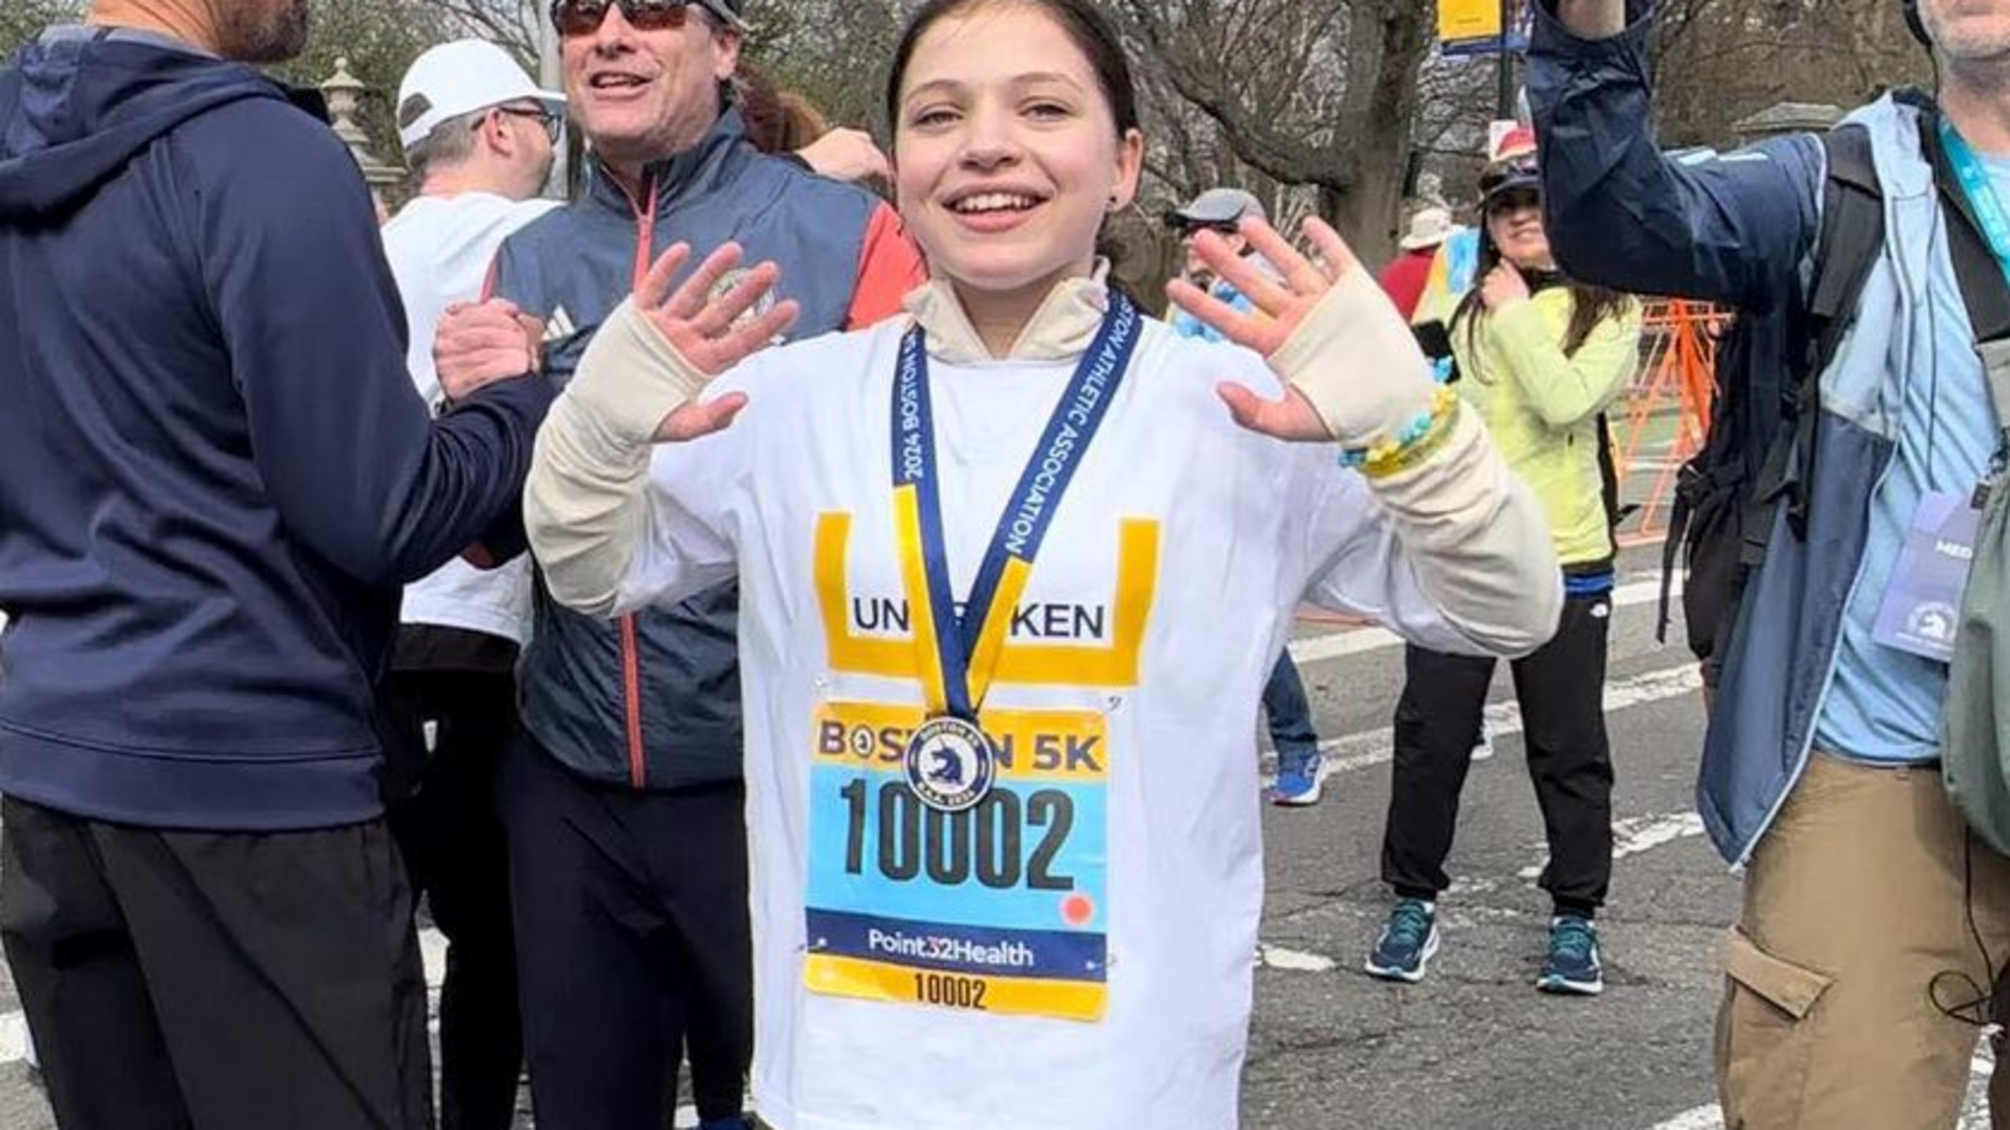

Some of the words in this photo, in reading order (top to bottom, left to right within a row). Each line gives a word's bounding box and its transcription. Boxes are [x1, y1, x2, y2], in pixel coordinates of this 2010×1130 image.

[1108, 294, 1135, 349] STON
[900, 353, 919, 431] BOSTON
[1068, 342, 1118, 426] ATHLETIC
[903, 432, 923, 480] 2024
[1005, 422, 1080, 555] ASSOCIATION
[853, 597, 1105, 639] UNKEN
[820, 718, 1013, 770] BOSN
[1033, 732, 1103, 773] 5K
[840, 778, 1075, 891] 10002
[868, 928, 1034, 967] Point32Health
[914, 972, 988, 1011] 10002
